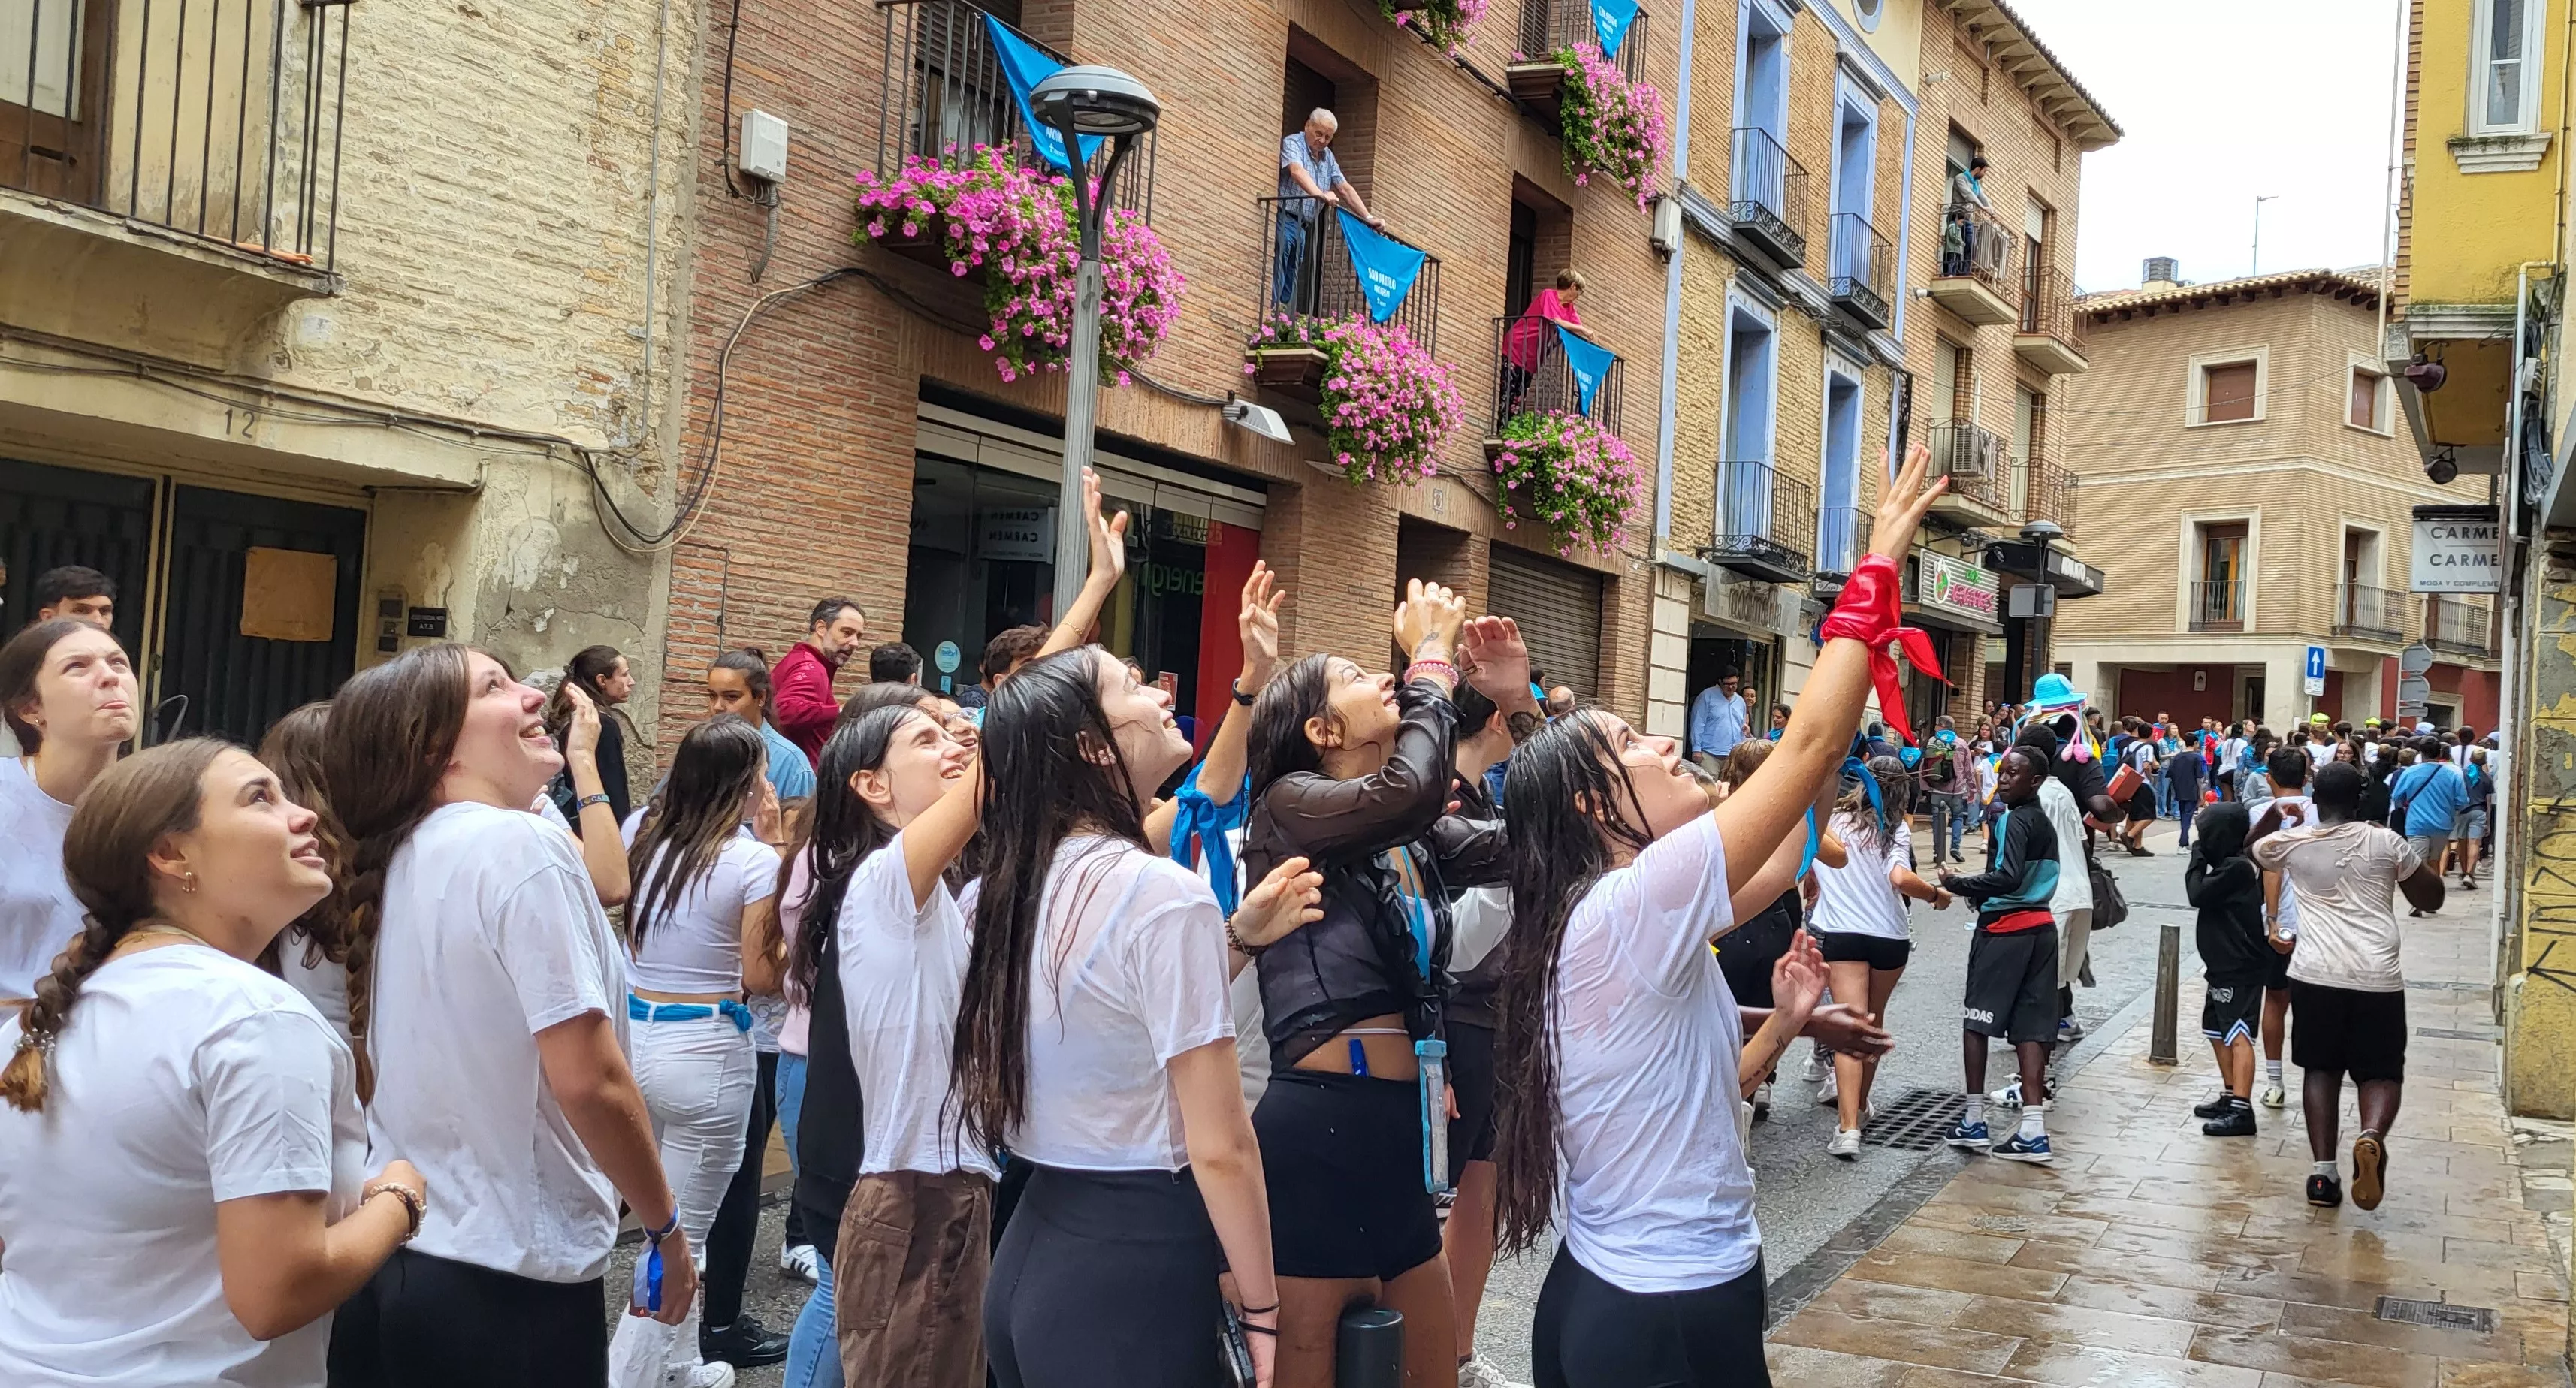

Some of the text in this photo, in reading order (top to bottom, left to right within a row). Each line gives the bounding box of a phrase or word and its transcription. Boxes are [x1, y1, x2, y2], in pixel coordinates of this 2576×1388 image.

[225, 408, 255, 439] 12
[2430, 526, 2499, 539] CARME
[2429, 554, 2500, 566] CARME
[2453, 580, 2499, 588] COMPLEME
[1964, 1007, 1995, 1024] DIDAS
